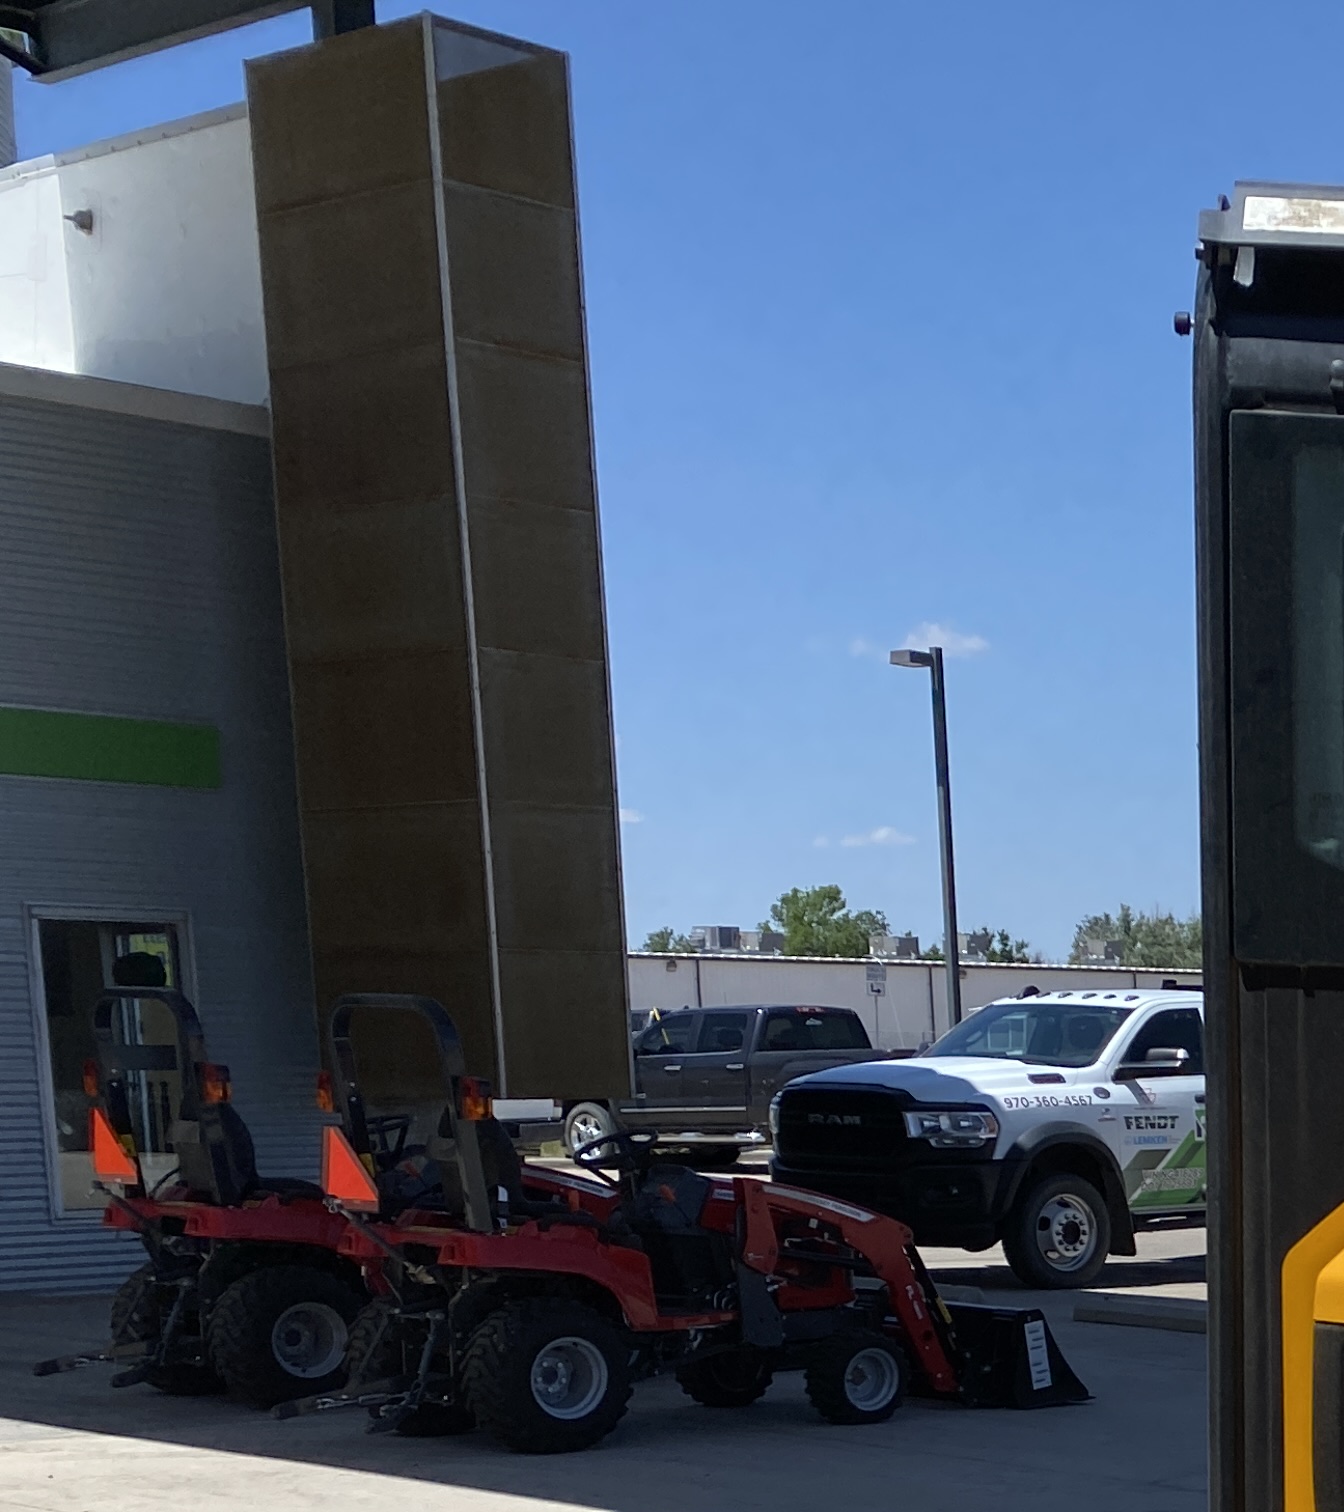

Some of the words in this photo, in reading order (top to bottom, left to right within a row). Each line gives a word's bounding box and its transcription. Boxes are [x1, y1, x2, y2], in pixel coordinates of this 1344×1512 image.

[1003, 1094, 1092, 1109] 970-360-4567
[808, 1113, 862, 1125] RAM
[1123, 1115, 1179, 1130] FENDT
